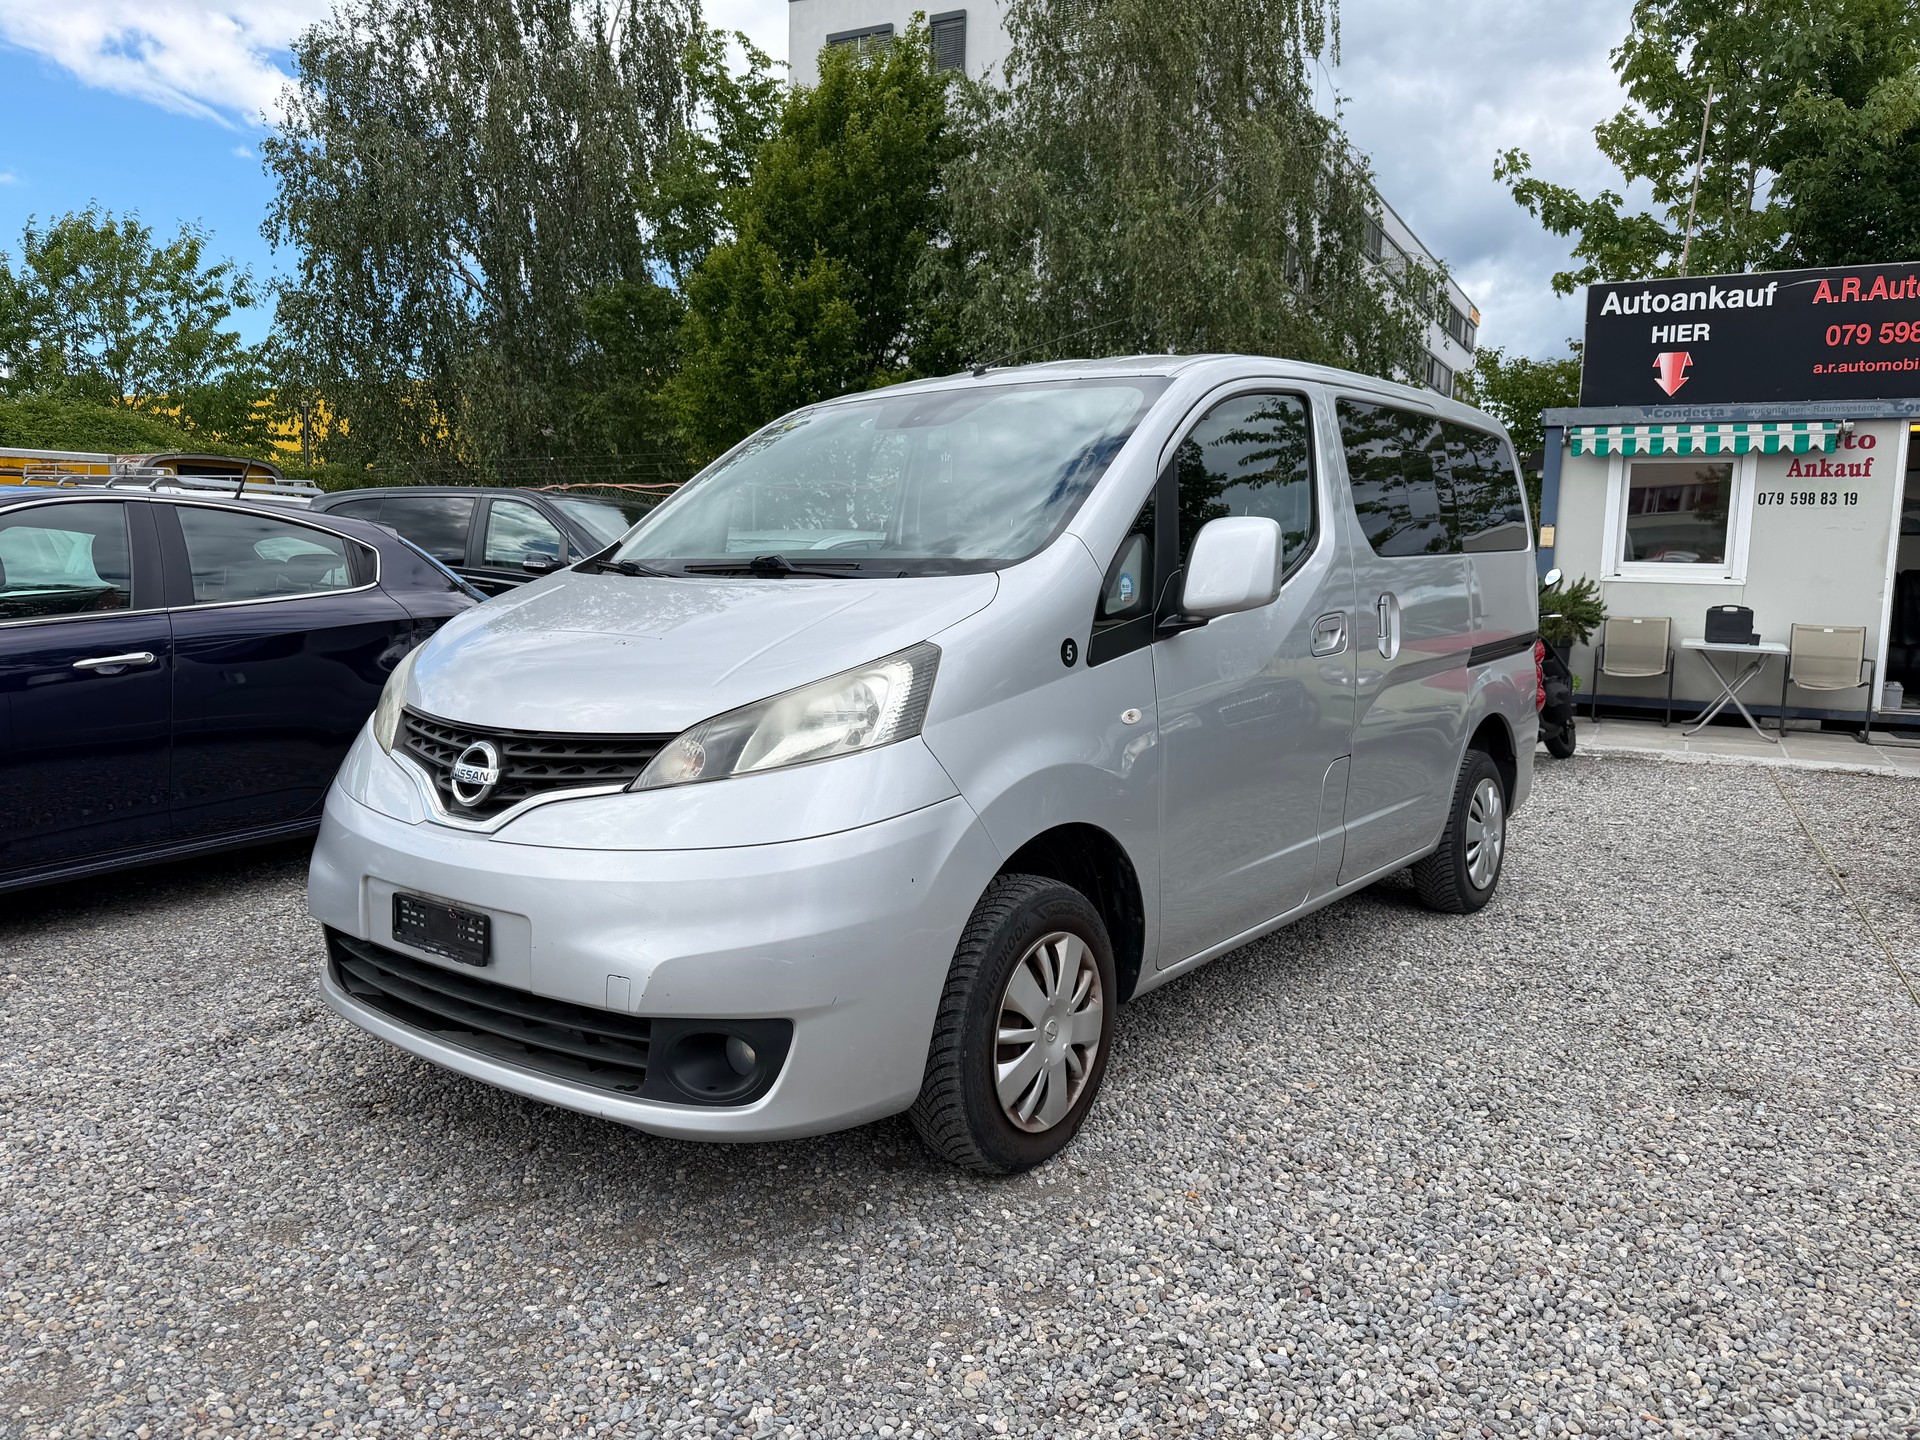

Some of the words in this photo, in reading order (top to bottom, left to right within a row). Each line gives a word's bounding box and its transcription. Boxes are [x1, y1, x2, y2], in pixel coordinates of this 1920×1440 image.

[1600, 281, 1778, 316] Autoankauf
[1812, 275, 1920, 304] A.R.Aut
[1651, 323, 1711, 343] HIER
[1825, 323, 1872, 346] 079
[1878, 320, 1920, 344] 598
[1813, 358, 1920, 374] a.r.automobi
[1653, 407, 1725, 418] Condecta
[1813, 404, 1882, 413] Raumsysteme
[1836, 431, 1876, 449] to
[1786, 457, 1875, 477] Ankauf
[1758, 492, 1785, 505] 079
[1790, 492, 1816, 505] 598
[1820, 492, 1837, 505] 83
[1843, 492, 1858, 505] 19
[1066, 644, 1073, 661] 5
